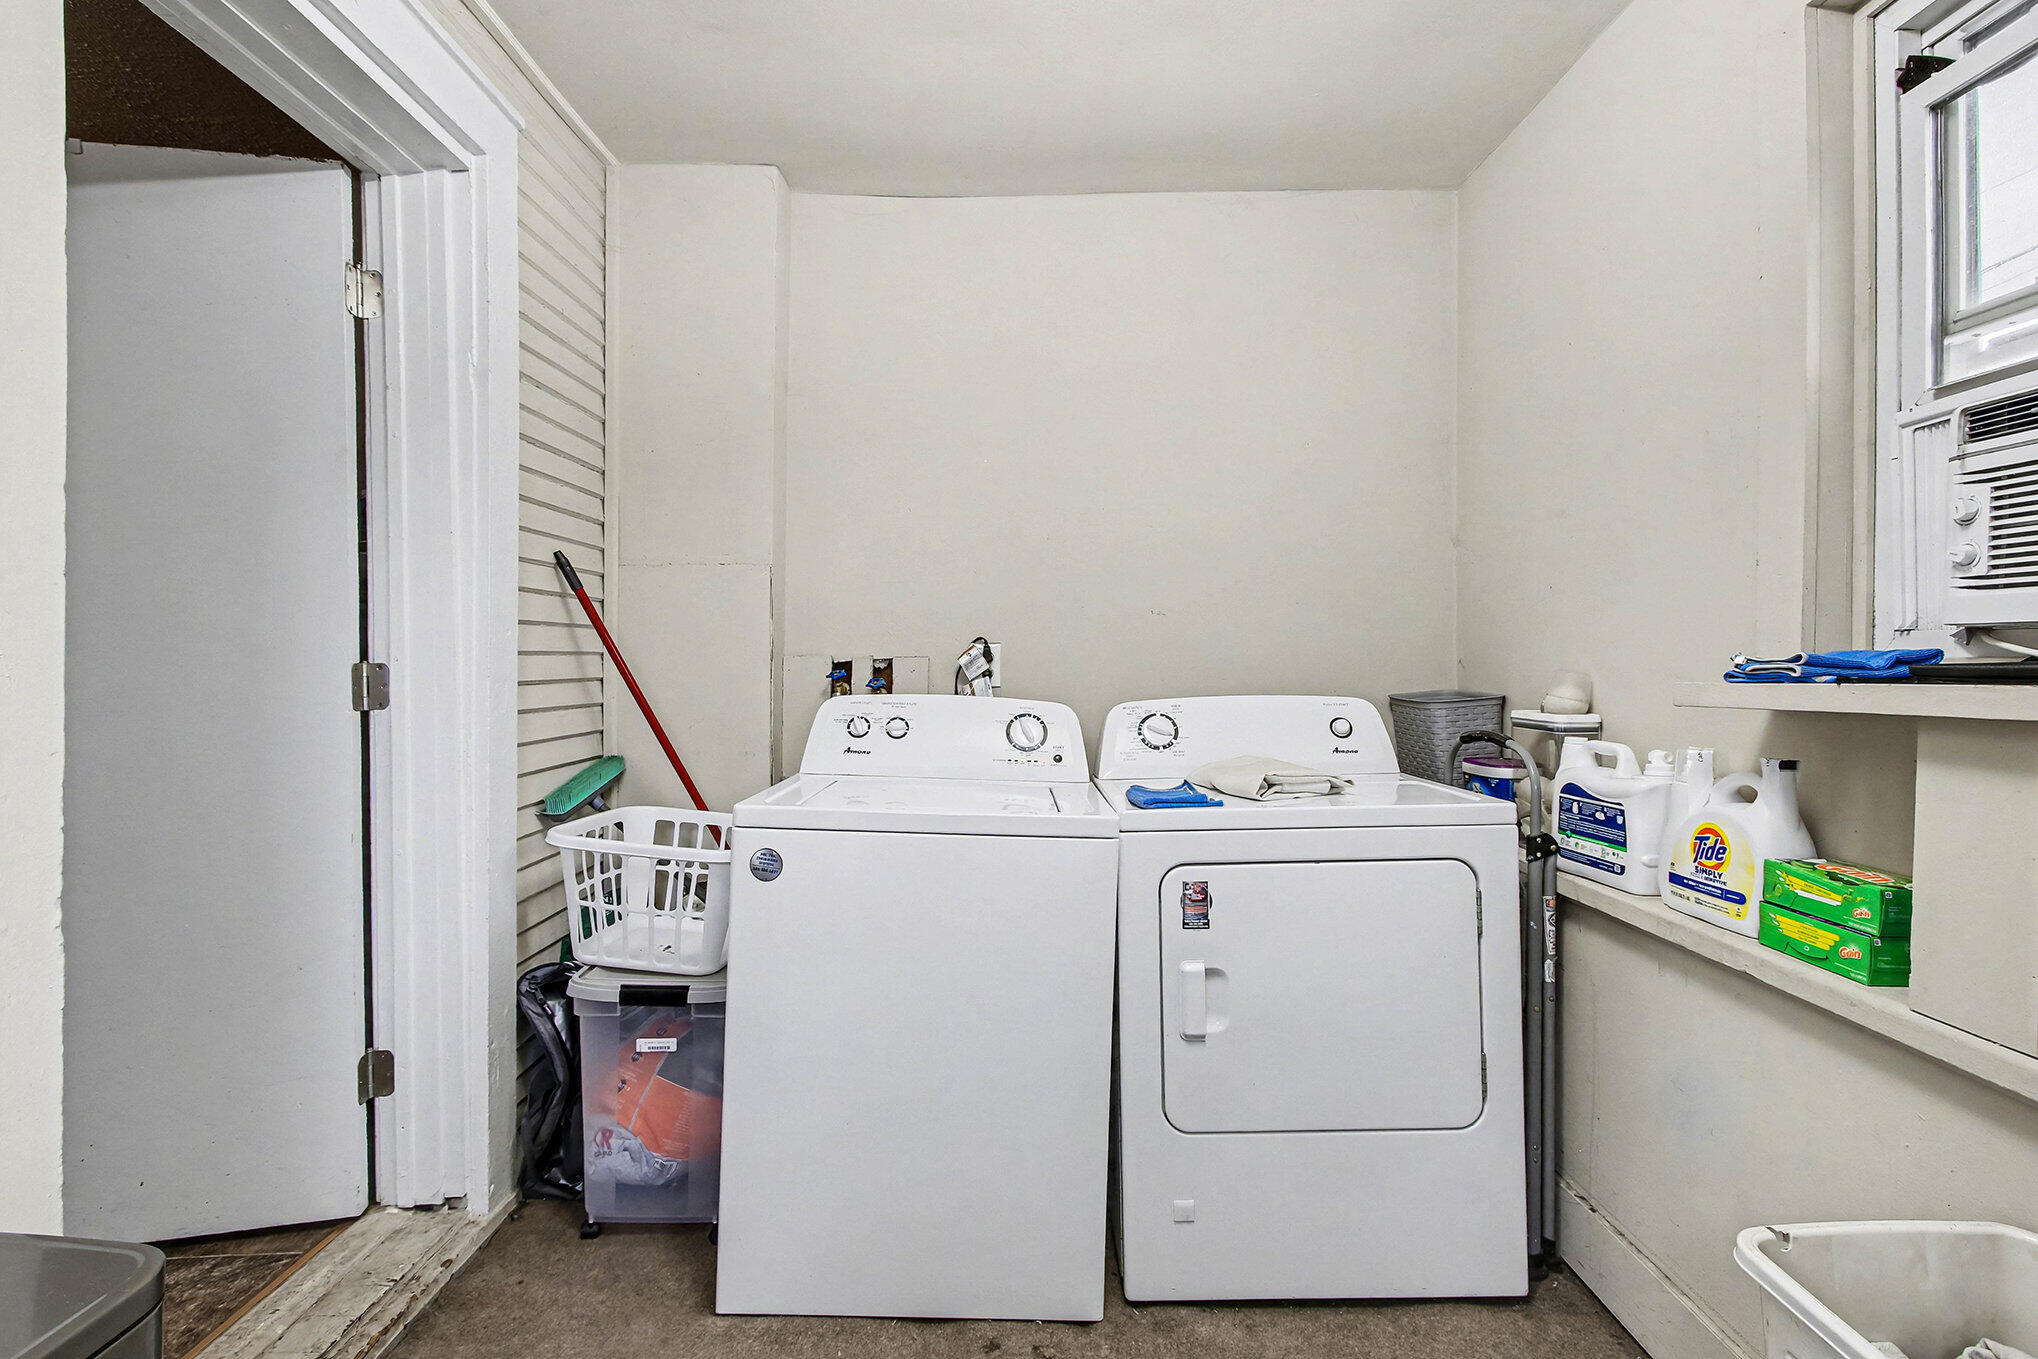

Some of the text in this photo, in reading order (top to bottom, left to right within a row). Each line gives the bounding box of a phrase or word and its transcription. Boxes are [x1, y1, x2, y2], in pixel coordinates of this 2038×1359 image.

[1693, 835, 1728, 865] Tide
[1694, 866, 1724, 880] SIMPLY
[1815, 864, 1895, 884] Gain
[1852, 908, 1872, 920] Gain
[1839, 946, 1862, 961] Gain
